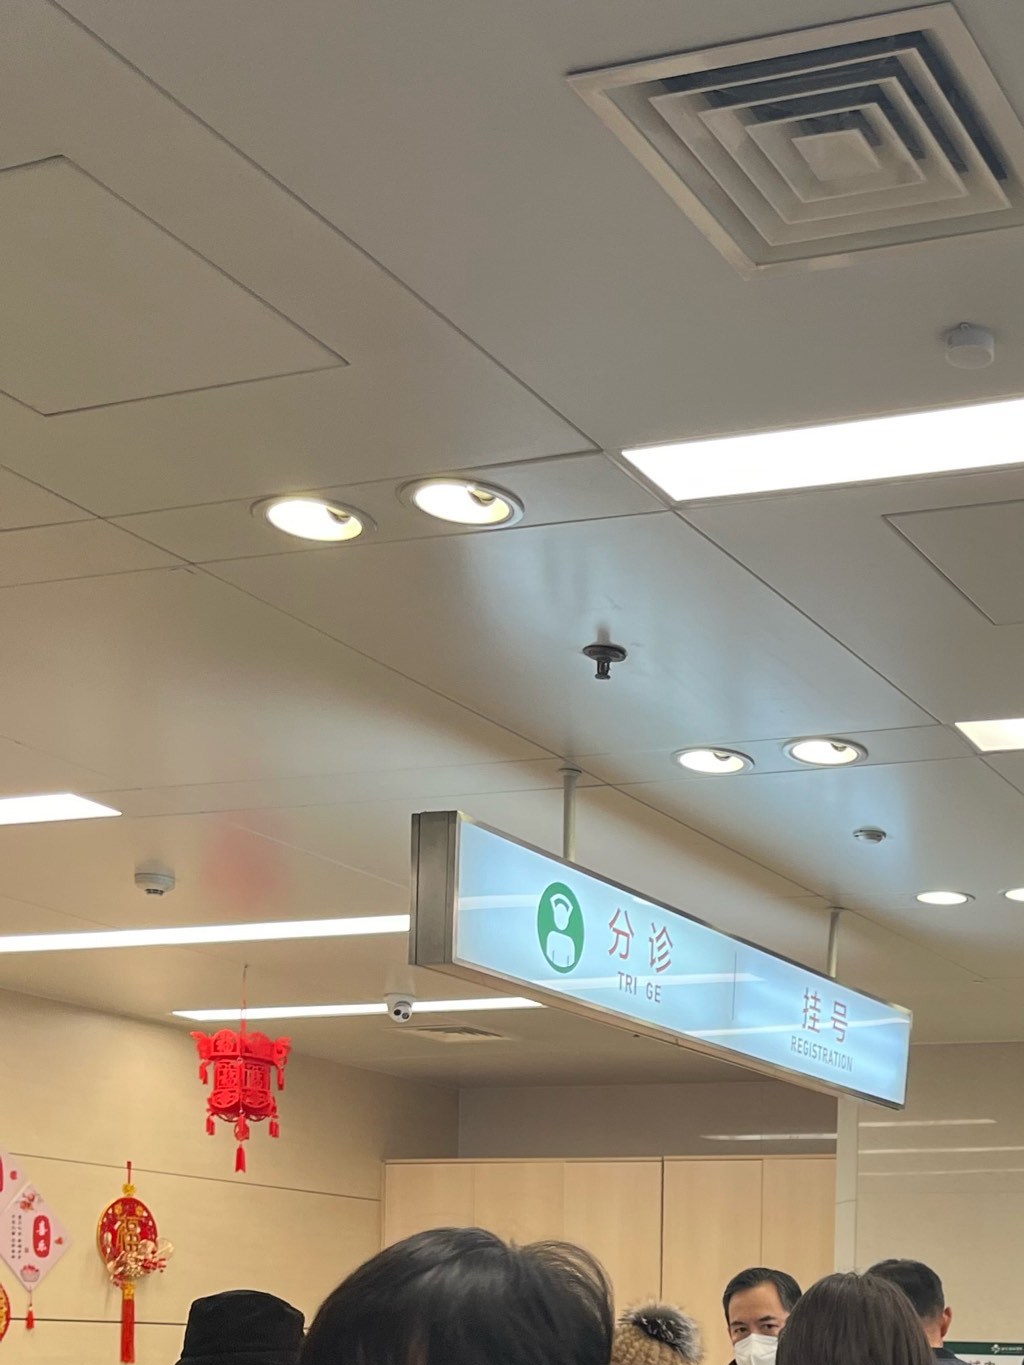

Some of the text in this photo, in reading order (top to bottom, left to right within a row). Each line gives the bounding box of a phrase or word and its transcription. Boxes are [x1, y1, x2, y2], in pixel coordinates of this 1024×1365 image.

[608, 907, 673, 973] 分诊
[802, 987, 848, 1043] 挂号
[790, 1035, 854, 1072] REGISTRATION
